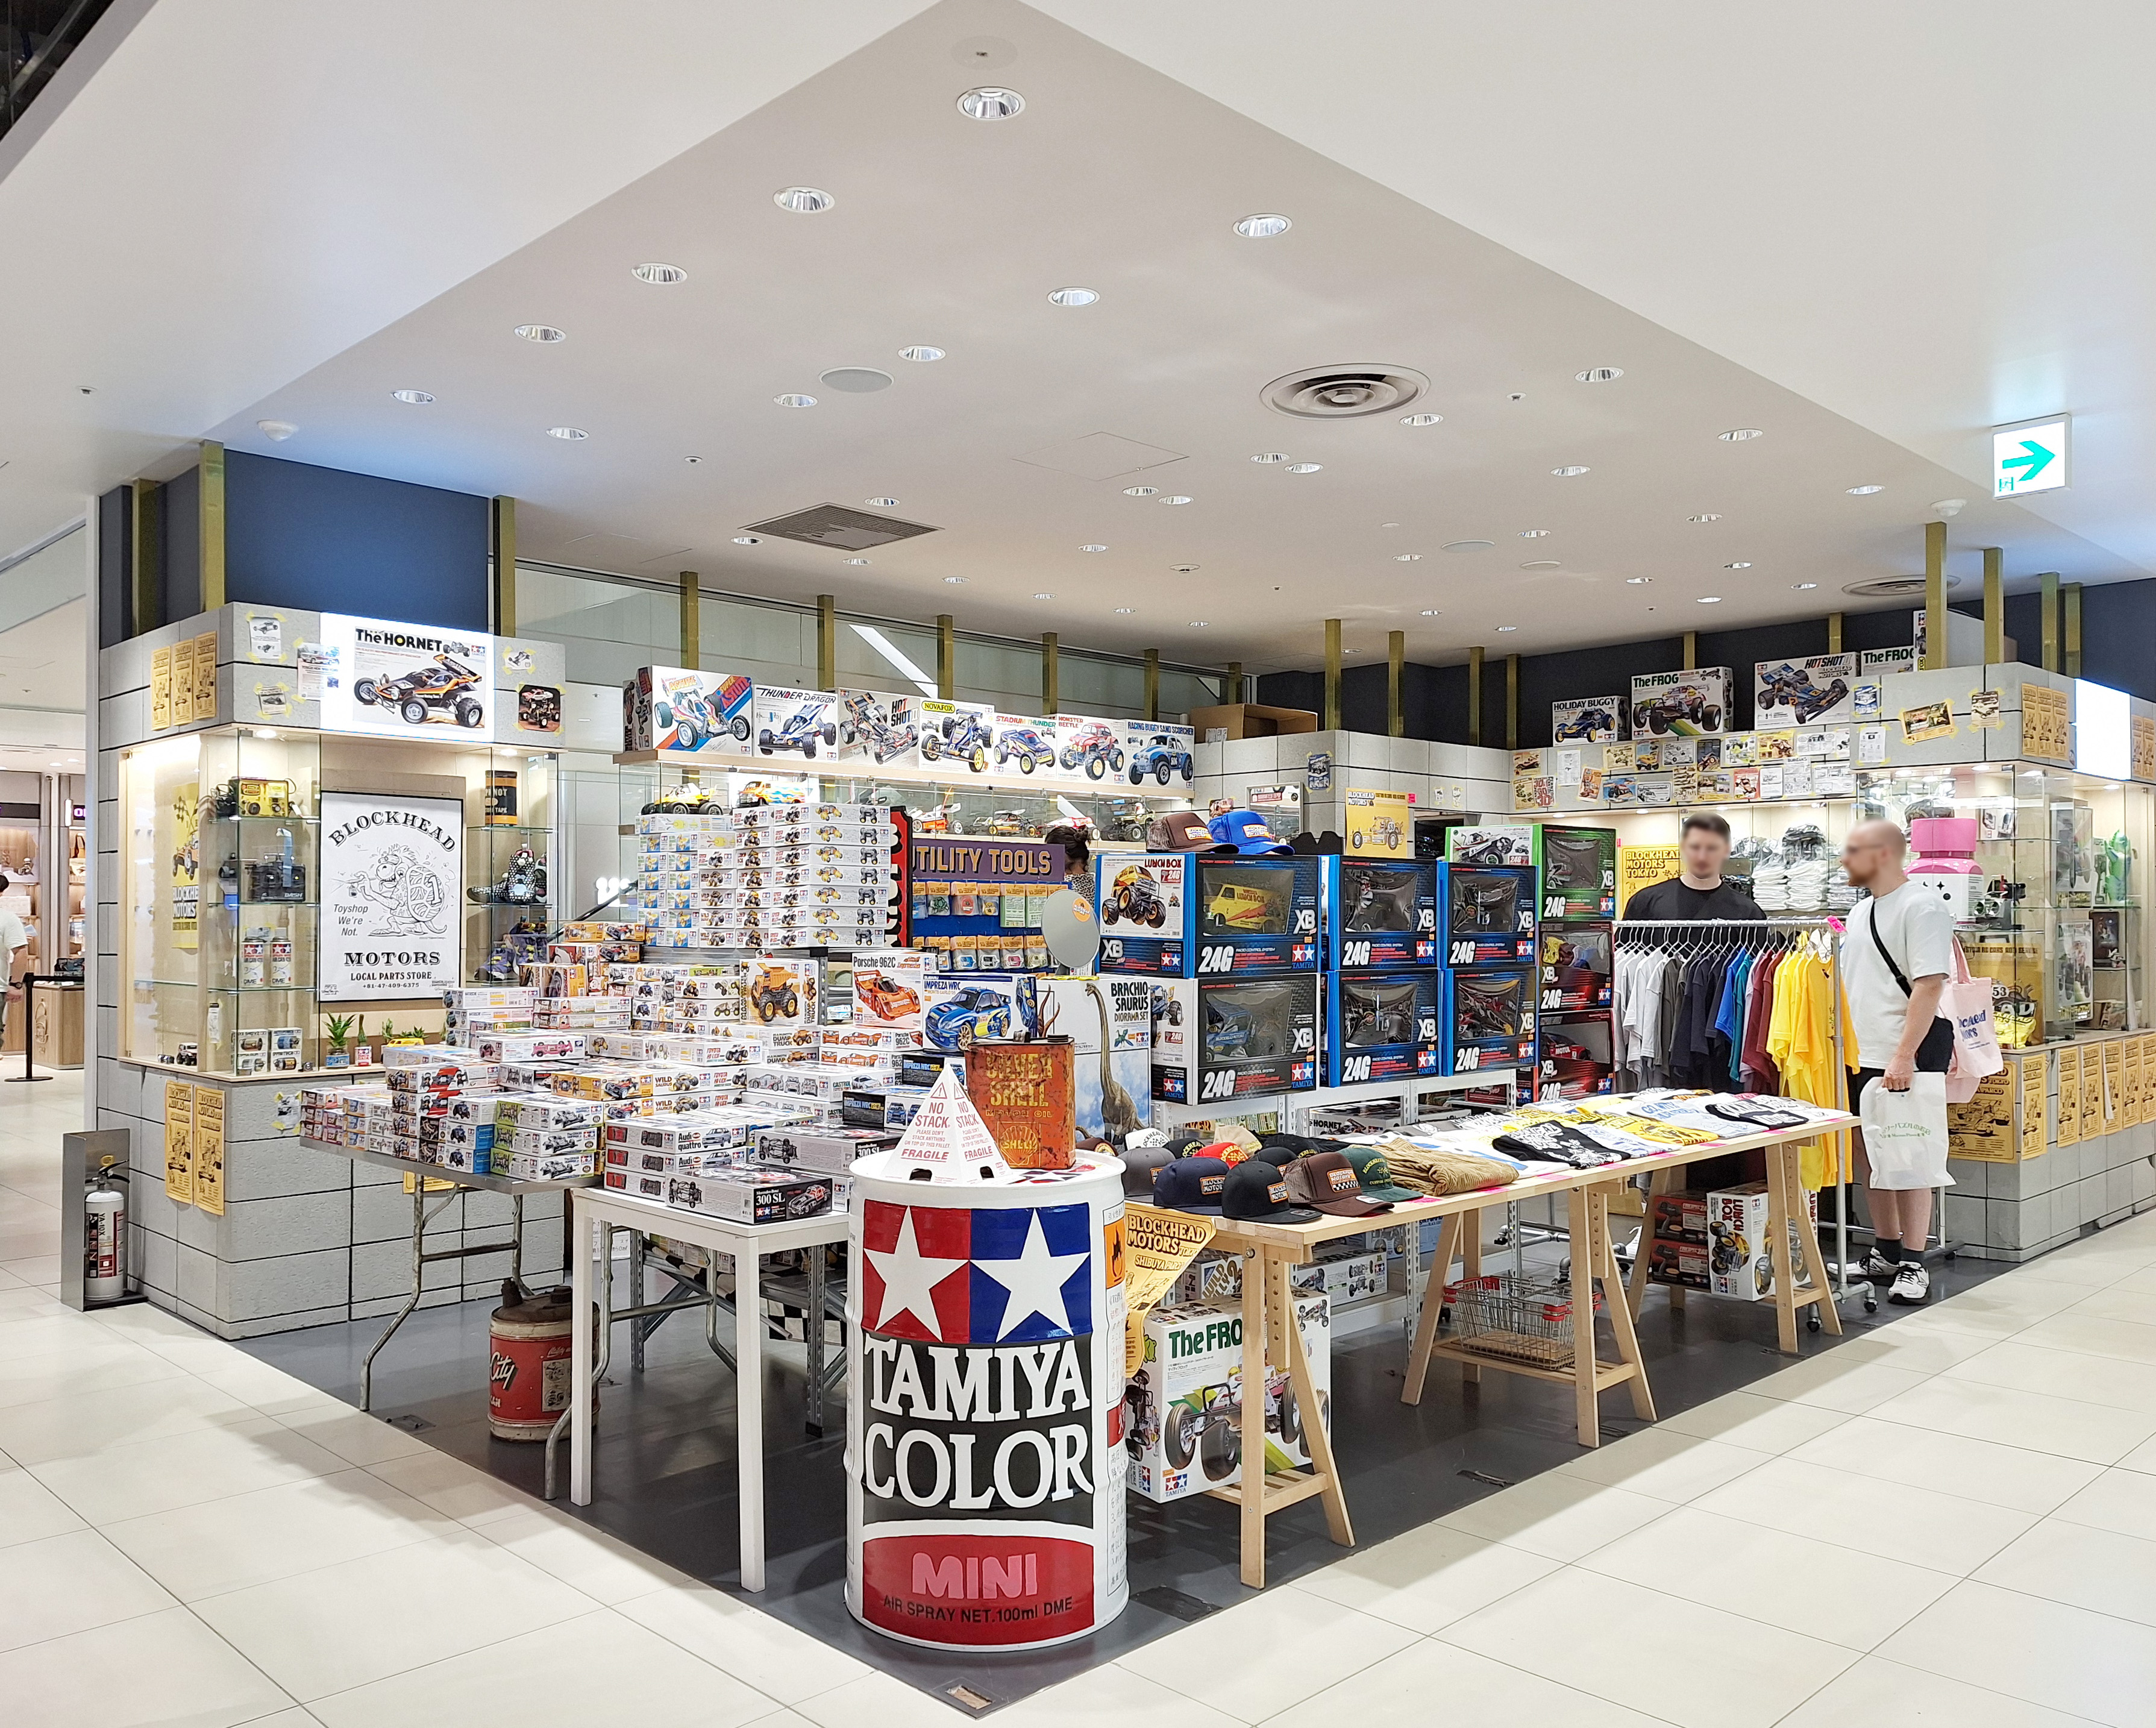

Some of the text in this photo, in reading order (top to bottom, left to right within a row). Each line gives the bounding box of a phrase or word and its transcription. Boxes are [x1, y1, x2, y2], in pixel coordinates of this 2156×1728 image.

[356, 628, 442, 652] The HORNET
[1864, 653, 1883, 664] The
[669, 676, 697, 691] ASTUTE
[719, 676, 736, 693] SUPER
[1633, 673, 1679, 688] The FROG
[756, 688, 837, 704] THUNDER DRAGON
[892, 698, 907, 712] HOT
[924, 702, 954, 712] NOVAFOX
[1553, 697, 1615, 711] HOLIDAY BUGGY
[891, 710, 911, 727] SHOT
[996, 715, 1056, 728] STADIUM THUNDER
[1058, 715, 1083, 724] MONSTER
[1348, 791, 1374, 799] BLOCKHEAD
[328, 811, 456, 852] BLOCKHEAD
[989, 849, 1051, 874] TOOLS
[1144, 858, 1182, 869] LUNCH BOX
[1626, 859, 1665, 870] MOTORS
[1626, 868, 1658, 879] TOKYO
[334, 903, 368, 914] Toyshop
[338, 916, 363, 925] We're
[341, 927, 359, 937] Not.
[344, 951, 440, 966] MOTORS
[853, 957, 879, 968] Porsche
[879, 957, 896, 969] 962C
[379, 972, 404, 980] PARTS
[924, 981, 961, 991] IMPREZA WRC
[1992, 987, 2007, 996] 53
[1115, 996, 1149, 1011] SAURUS
[1115, 1011, 1149, 1023] DIORAMA SET
[895, 1037, 910, 1046] 962C
[1555, 1046, 1570, 1055] MOTUL
[985, 1053, 1053, 1079] SILVER
[1292, 1080, 1314, 1089] TAMIYA
[989, 1081, 1050, 1107] SHELL
[929, 1102, 944, 1114] NO
[957, 1102, 968, 1113] NO
[985, 1109, 1029, 1117] MOTOR
[915, 1115, 949, 1129] STACK
[956, 1114, 979, 1128] STACK
[1314, 1119, 1342, 1129] HORNET
[678, 1132, 692, 1141] Audi
[678, 1141, 701, 1151] quattro
[1002, 1139, 1038, 1151] SHELL
[901, 1148, 949, 1160] FRAGILE
[965, 1146, 992, 1160] FRAGILE
[756, 1193, 786, 1205] 300 SL
[1722, 1198, 1733, 1221] BOX
[1733, 1198, 1744, 1231] LUNCH
[1127, 1214, 1207, 1244] BLOCKHEAD
[1127, 1230, 1180, 1256] MOTORS
[1135, 1254, 1167, 1270] SHIBUYA
[1168, 1329, 1205, 1359] The
[864, 1333, 1090, 1421] TAMIYA
[864, 1422, 1094, 1509] COLOR
[1165, 1487, 1186, 1497] TAMIYA
[911, 1552, 1038, 1600] MINI
[883, 1597, 903, 1613] AIR
[907, 1601, 956, 1622] SPRAY
[1043, 1597, 1073, 1615] DME
